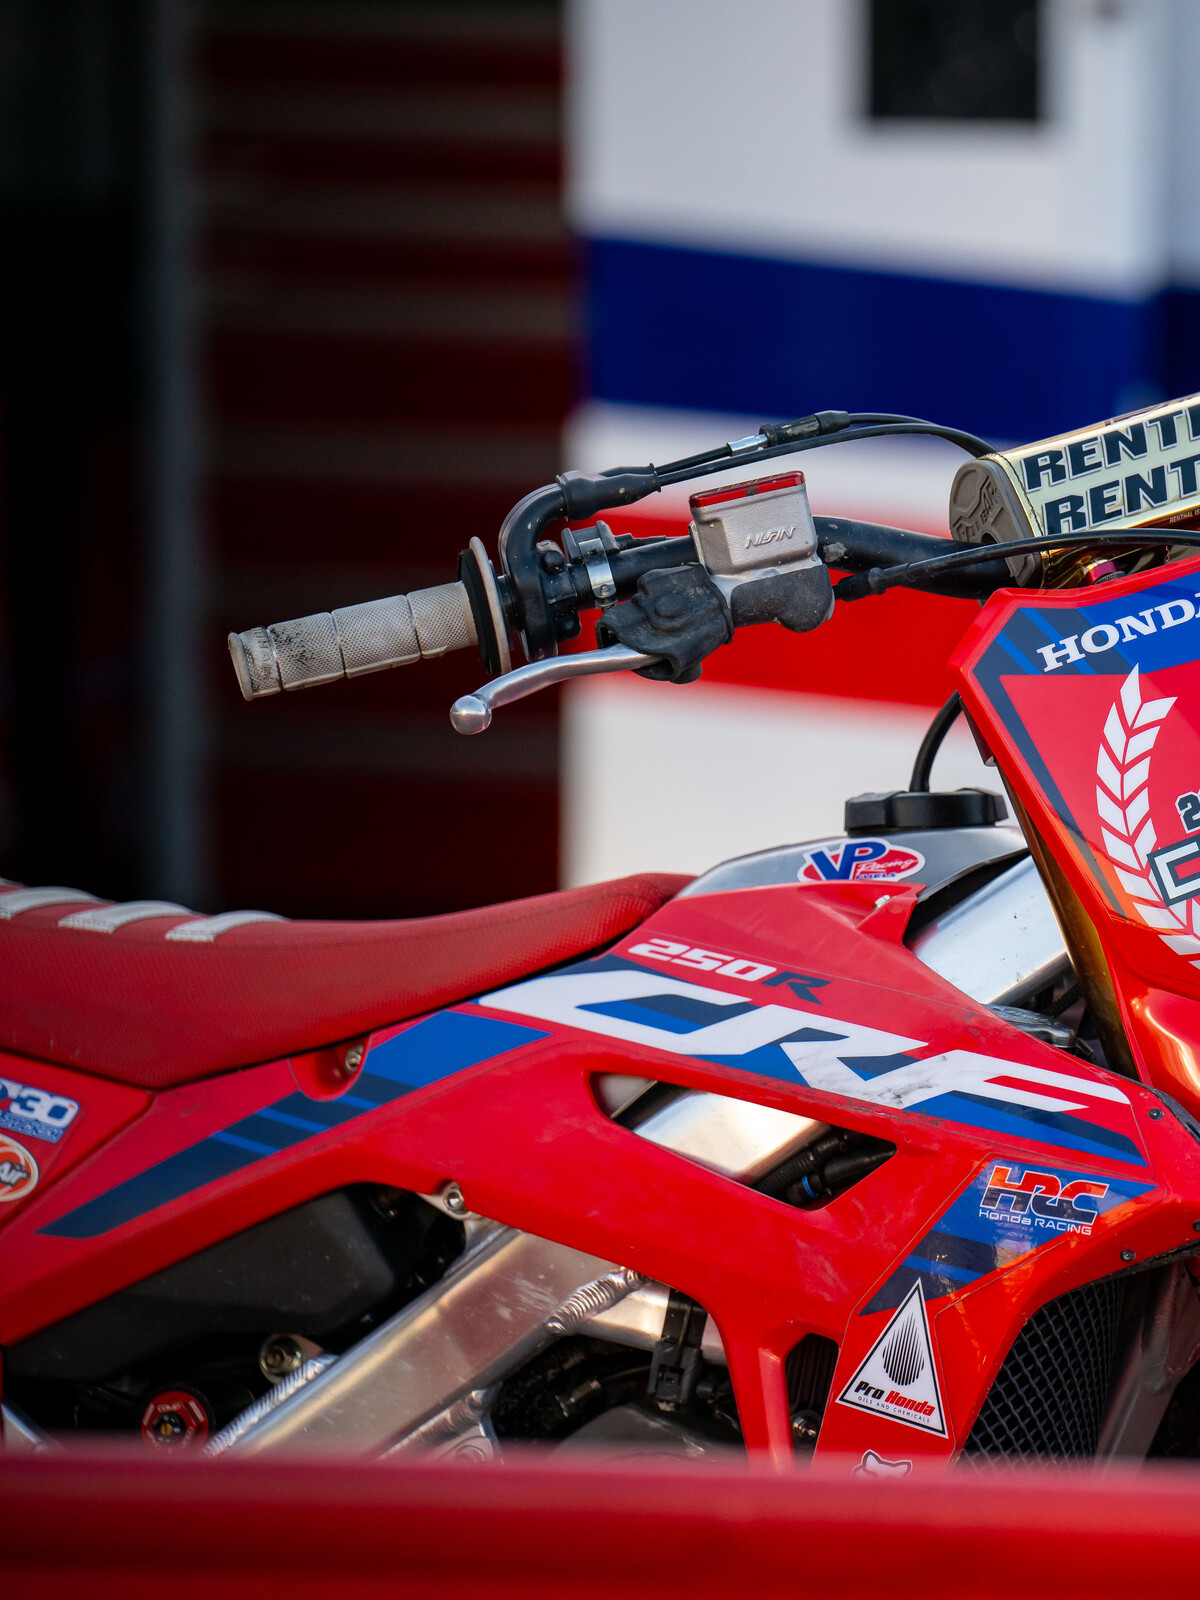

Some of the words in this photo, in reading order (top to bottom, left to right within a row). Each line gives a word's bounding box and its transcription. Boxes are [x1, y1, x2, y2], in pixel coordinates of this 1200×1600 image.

[808, 840, 888, 881] VP
[478, 970, 1132, 1111] CRF
[980, 1165, 1110, 1226] HRC
[979, 1208, 1031, 1226] Honda
[1034, 1218, 1093, 1236] RACING
[854, 1380, 885, 1400] Pro
[885, 1390, 936, 1416] Honda
[858, 1395, 873, 1405] OILS
[876, 1402, 890, 1410] AND
[893, 1407, 930, 1423] CHEMICALS
